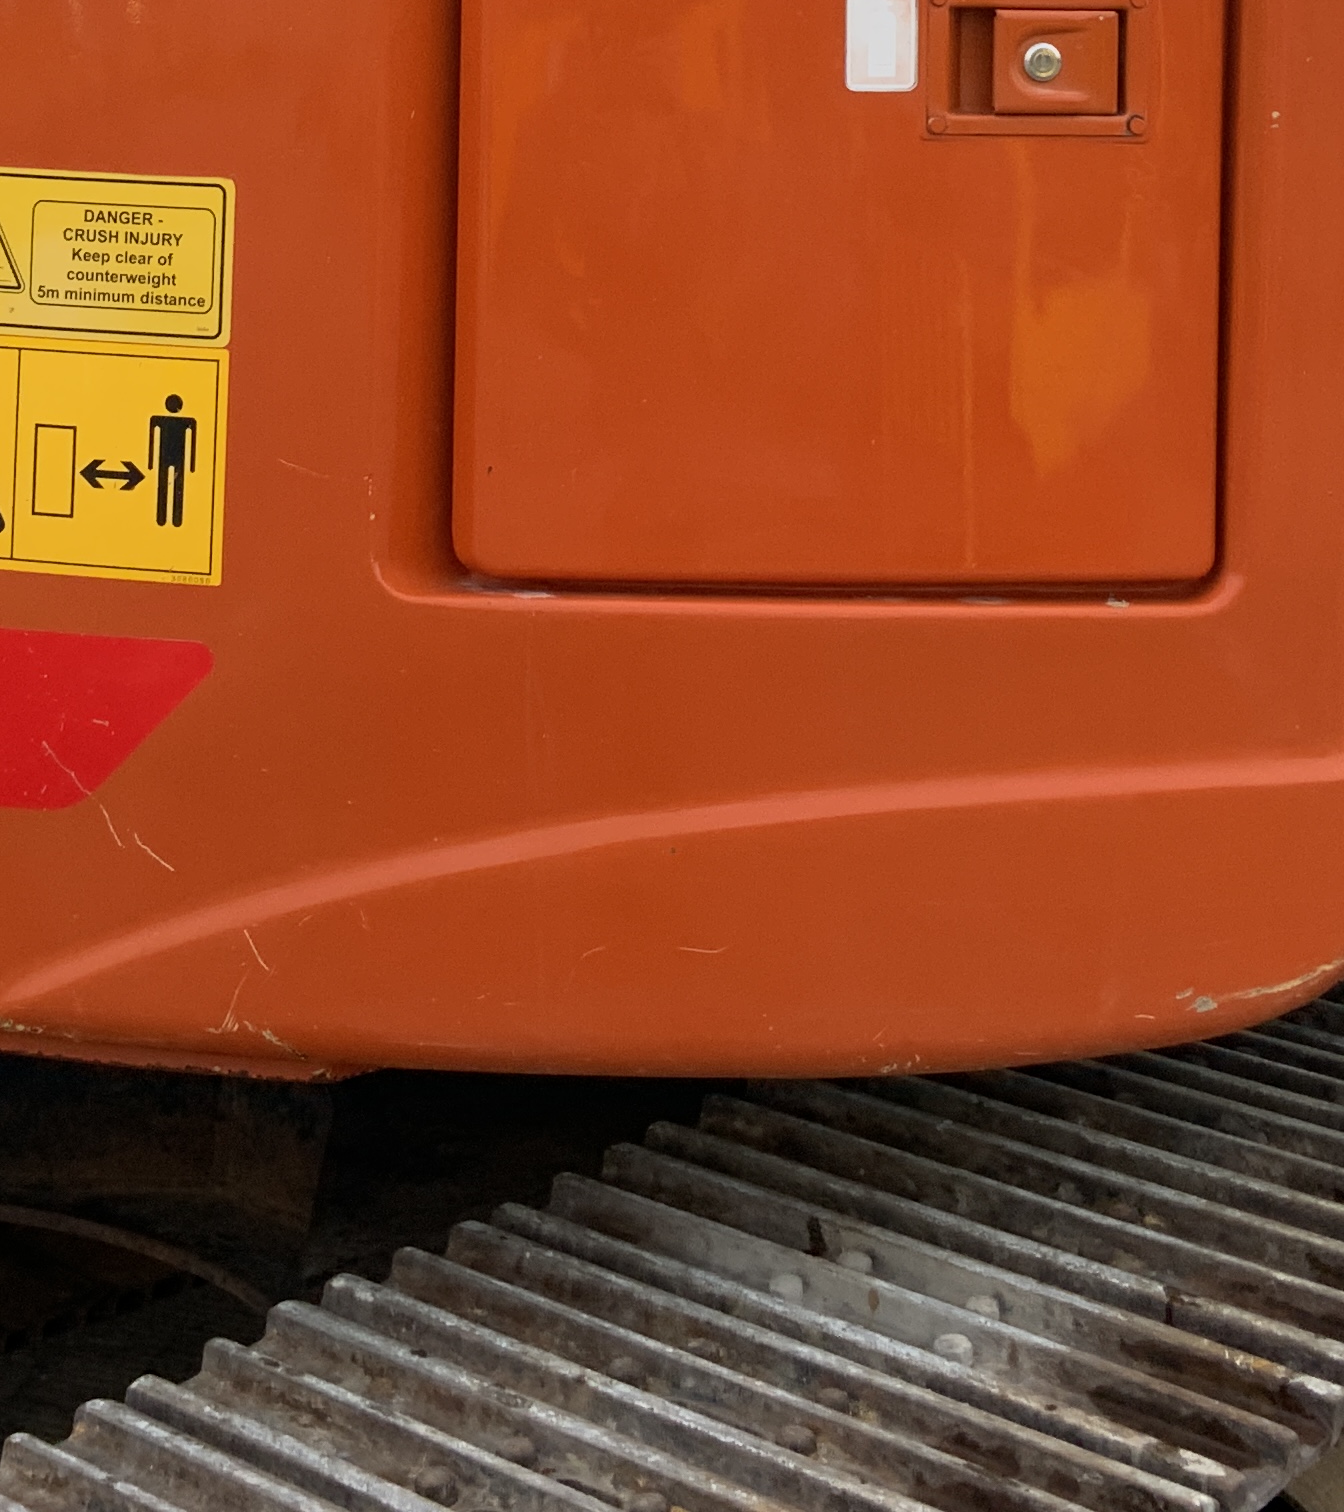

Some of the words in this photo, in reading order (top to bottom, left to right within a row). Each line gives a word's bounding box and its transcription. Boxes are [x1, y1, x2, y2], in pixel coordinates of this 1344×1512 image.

[83, 209, 154, 226] DANGER
[63, 228, 119, 244] CRUSH
[124, 230, 184, 247] INJURY
[71, 248, 111, 265] Keep
[115, 250, 153, 265] clear
[157, 253, 174, 266] of
[66, 269, 177, 288] counterweight
[37, 285, 60, 299] 5m
[64, 287, 135, 304] minimum
[140, 291, 206, 308] distance
